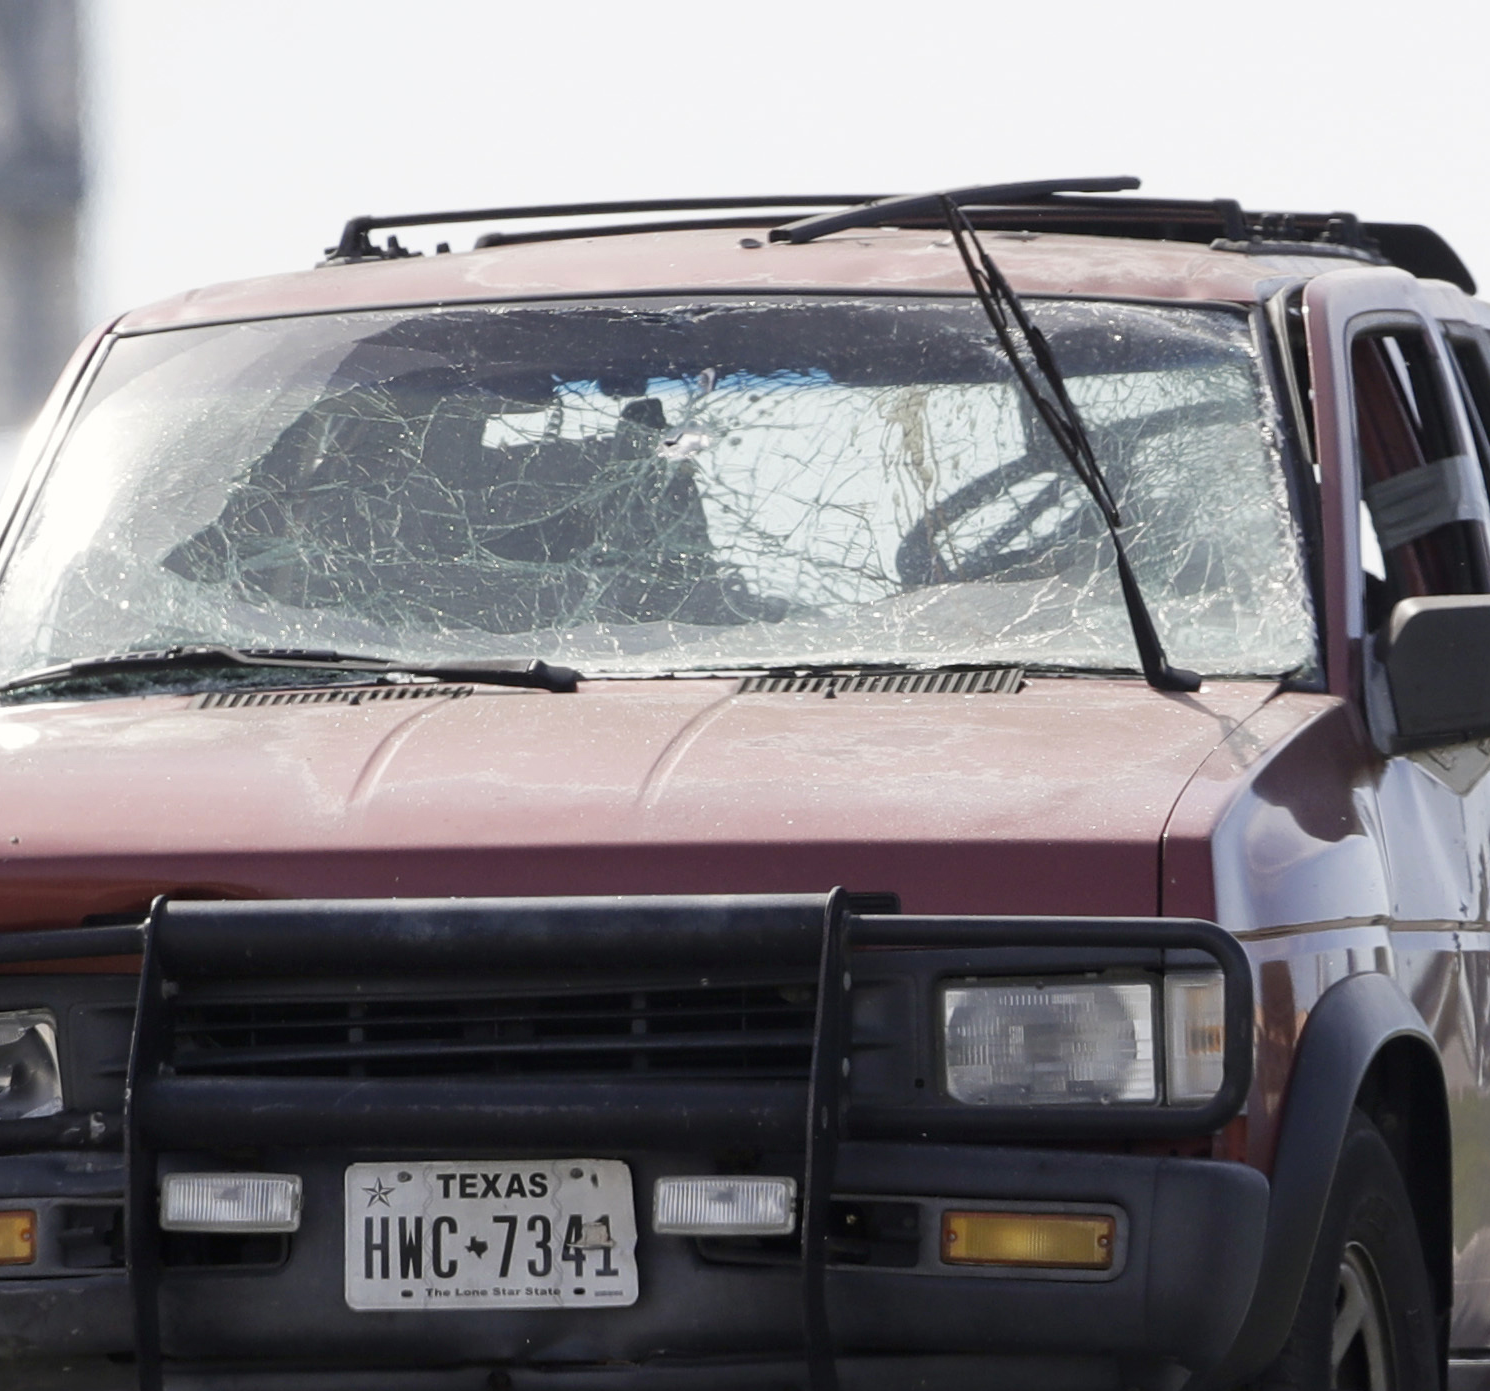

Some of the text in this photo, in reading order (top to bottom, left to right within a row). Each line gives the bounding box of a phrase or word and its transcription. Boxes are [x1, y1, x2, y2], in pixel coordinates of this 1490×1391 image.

[436, 1172, 549, 1199] TEXAS
[364, 1213, 619, 1280] HWC 7341
[425, 1287, 562, 1297] The Lone Star State
